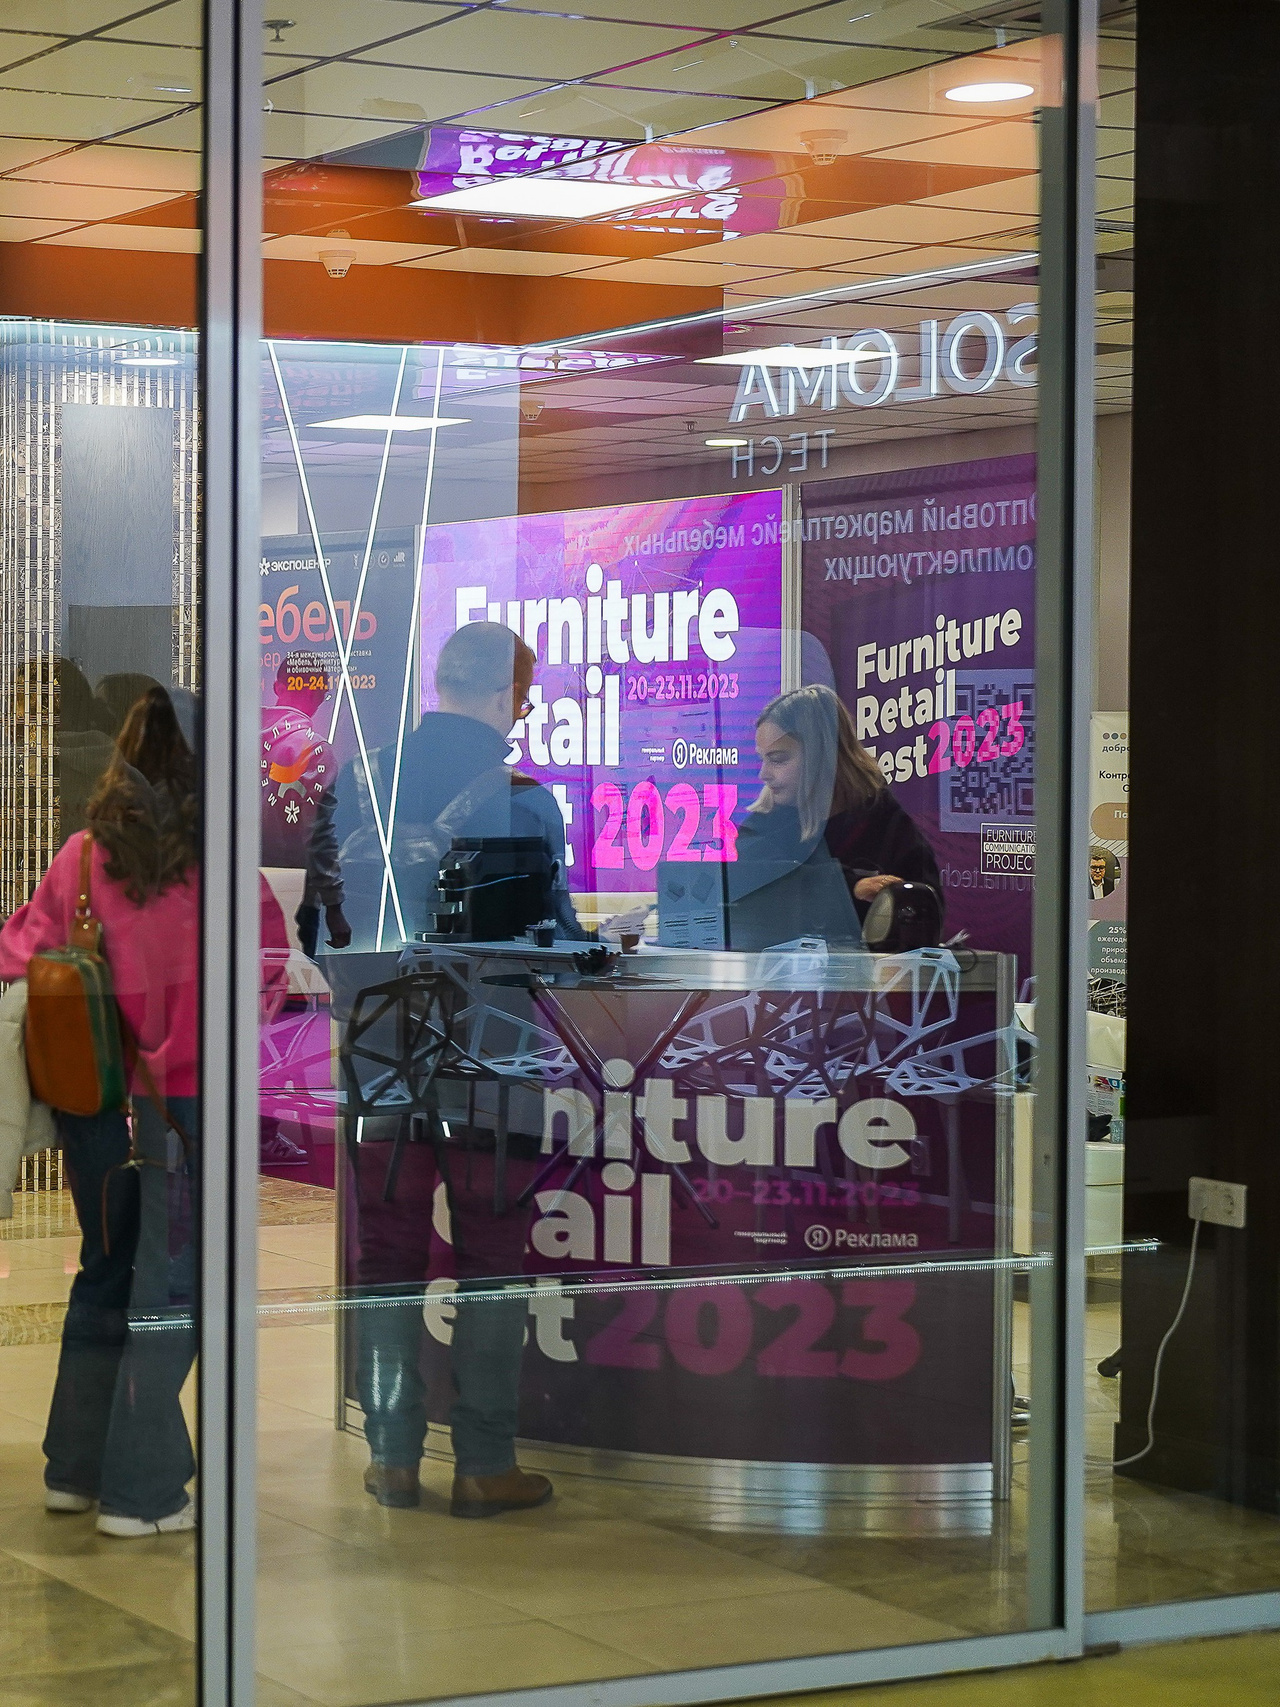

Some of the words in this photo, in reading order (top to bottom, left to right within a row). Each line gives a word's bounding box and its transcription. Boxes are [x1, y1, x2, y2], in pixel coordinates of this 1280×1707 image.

[271, 558, 331, 572] ЭКСПОЦЕНР
[300, 651, 340, 660] международн
[857, 608, 1022, 689] Furniture
[313, 658, 341, 668] фурнитур
[287, 674, 376, 691] 20-24.11023
[857, 668, 956, 741] Retail
[928, 701, 1025, 775] 2023
[689, 743, 739, 765] Реклама
[1099, 770, 1130, 782] Контр
[590, 781, 739, 871] 2023
[1090, 967, 1128, 975] производ
[834, 1228, 919, 1248] Реклама
[585, 1282, 919, 1379] 2023
